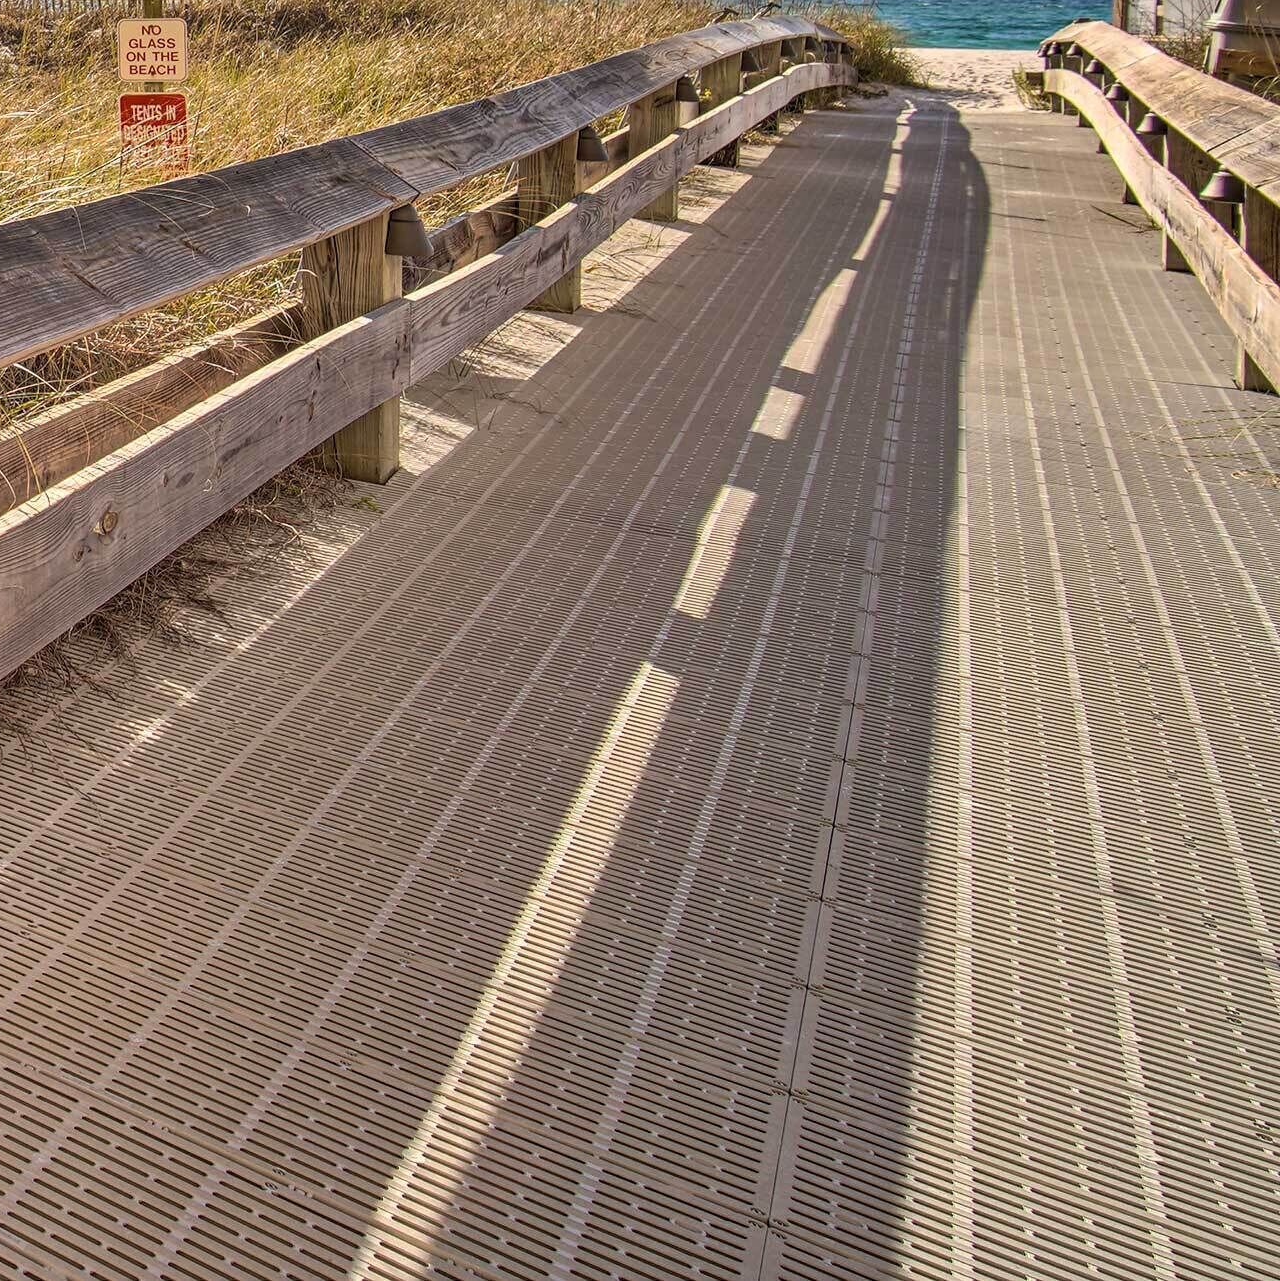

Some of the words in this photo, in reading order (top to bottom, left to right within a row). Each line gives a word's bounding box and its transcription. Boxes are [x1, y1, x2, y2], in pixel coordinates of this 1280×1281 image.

[141, 25, 162, 36] NO
[128, 38, 176, 49] GLASS
[126, 52, 146, 62] ON
[152, 51, 179, 62] THE
[129, 65, 176, 75] BEACH
[130, 105, 162, 120] TENTS
[165, 105, 176, 120] IN
[122, 124, 185, 140] DESIGNED
